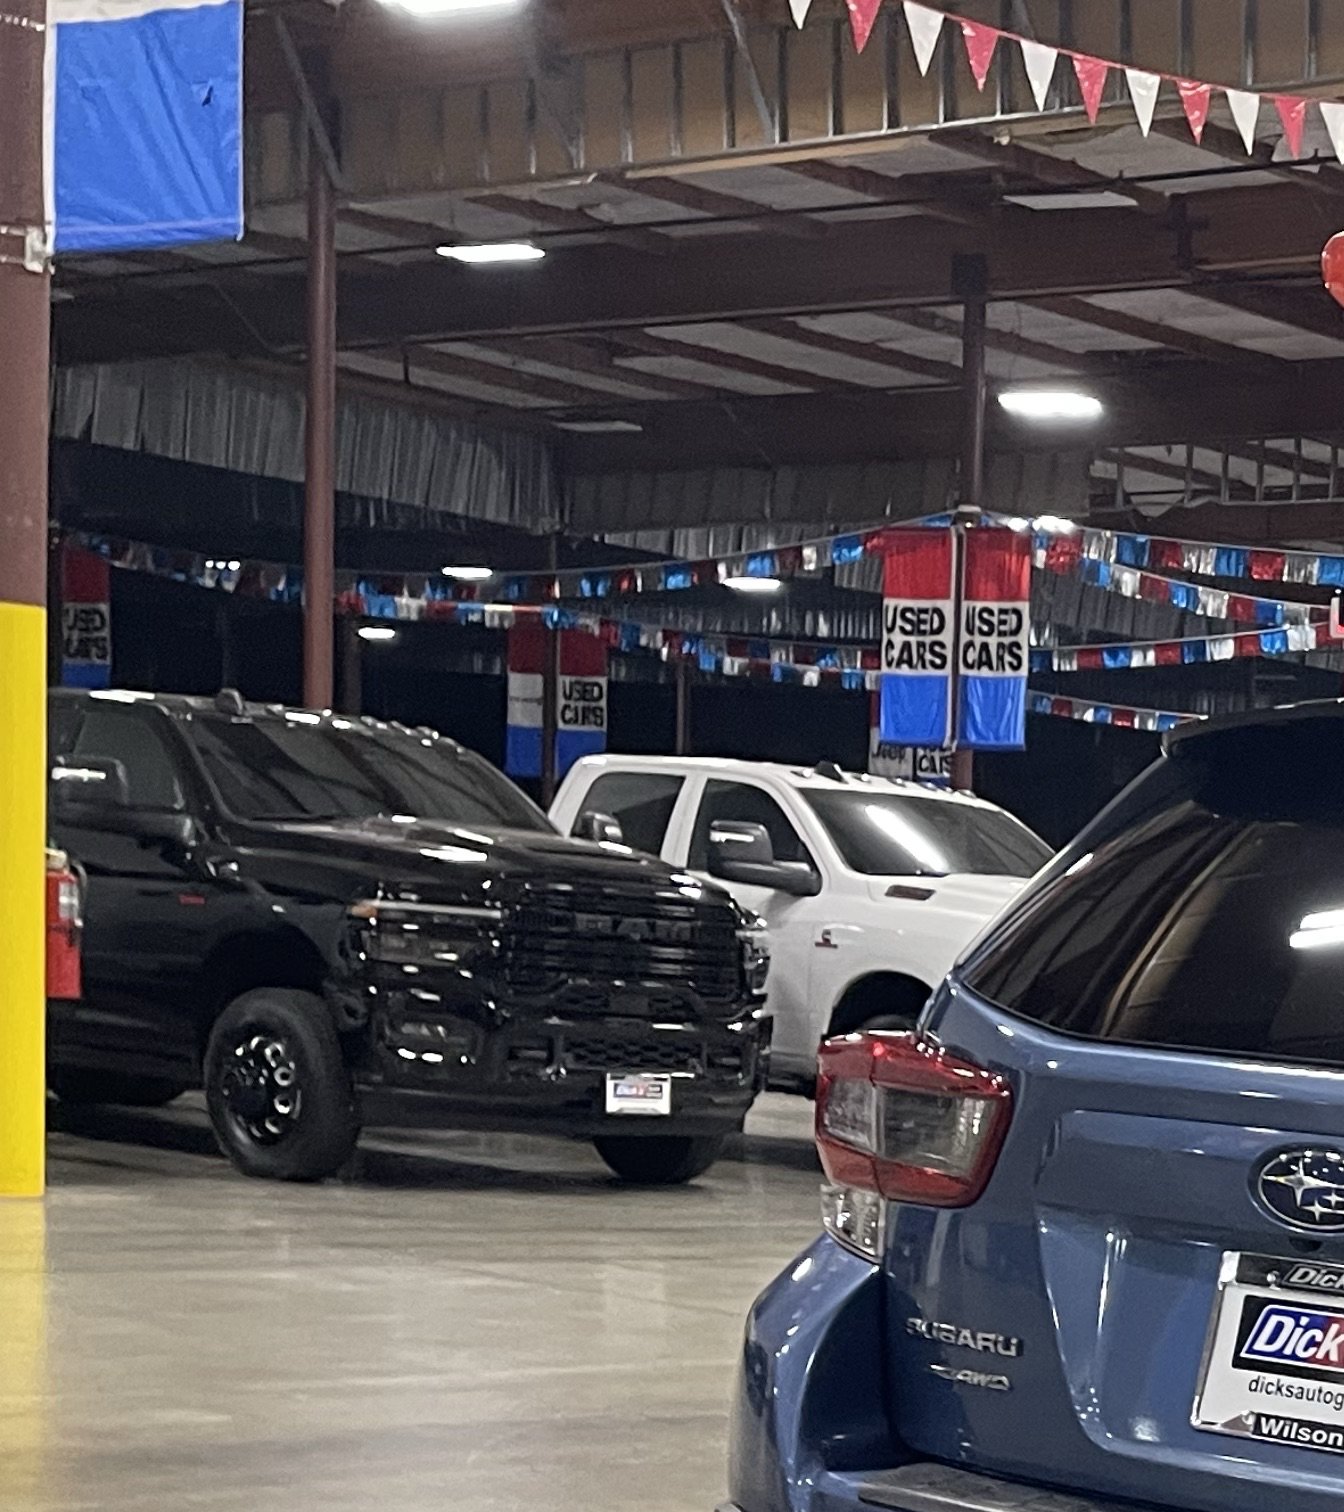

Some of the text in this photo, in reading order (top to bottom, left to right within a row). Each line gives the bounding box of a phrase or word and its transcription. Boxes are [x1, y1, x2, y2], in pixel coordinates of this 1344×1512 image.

[886, 605, 946, 636] USED
[965, 607, 1023, 637] USED
[885, 641, 948, 670] CARS
[962, 641, 1023, 671] CARS
[562, 681, 603, 702] USED
[561, 704, 604, 727] CARS
[905, 1317, 1021, 1357] SUBARU
